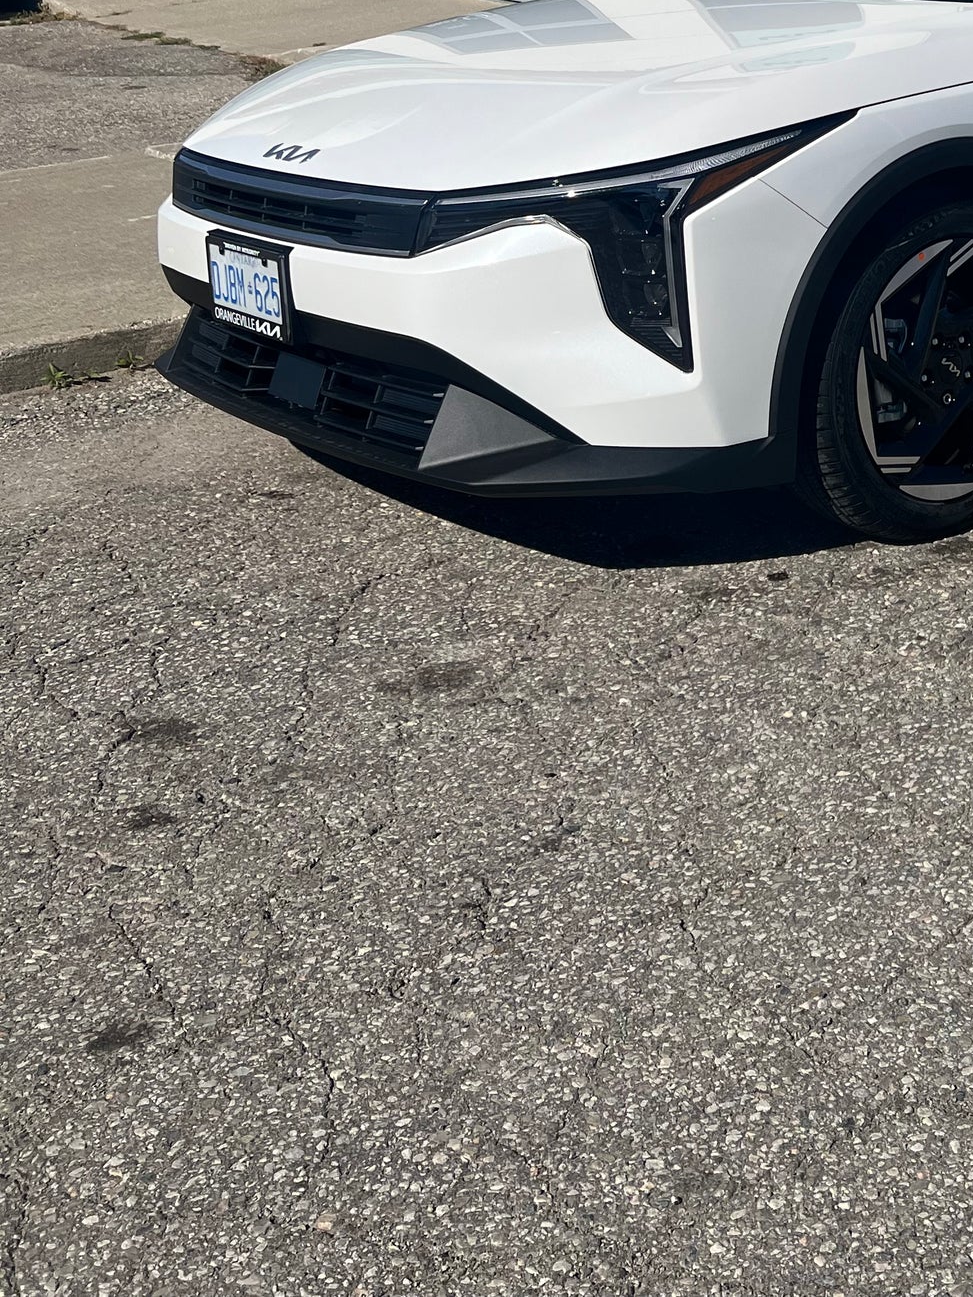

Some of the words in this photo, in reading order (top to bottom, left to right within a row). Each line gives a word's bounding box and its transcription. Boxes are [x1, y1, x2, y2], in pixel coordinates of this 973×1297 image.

[262, 142, 321, 164] KIA
[253, 272, 281, 319] 625
[214, 306, 255, 331] ORANGEVILLE
[255, 319, 281, 339] KIA
